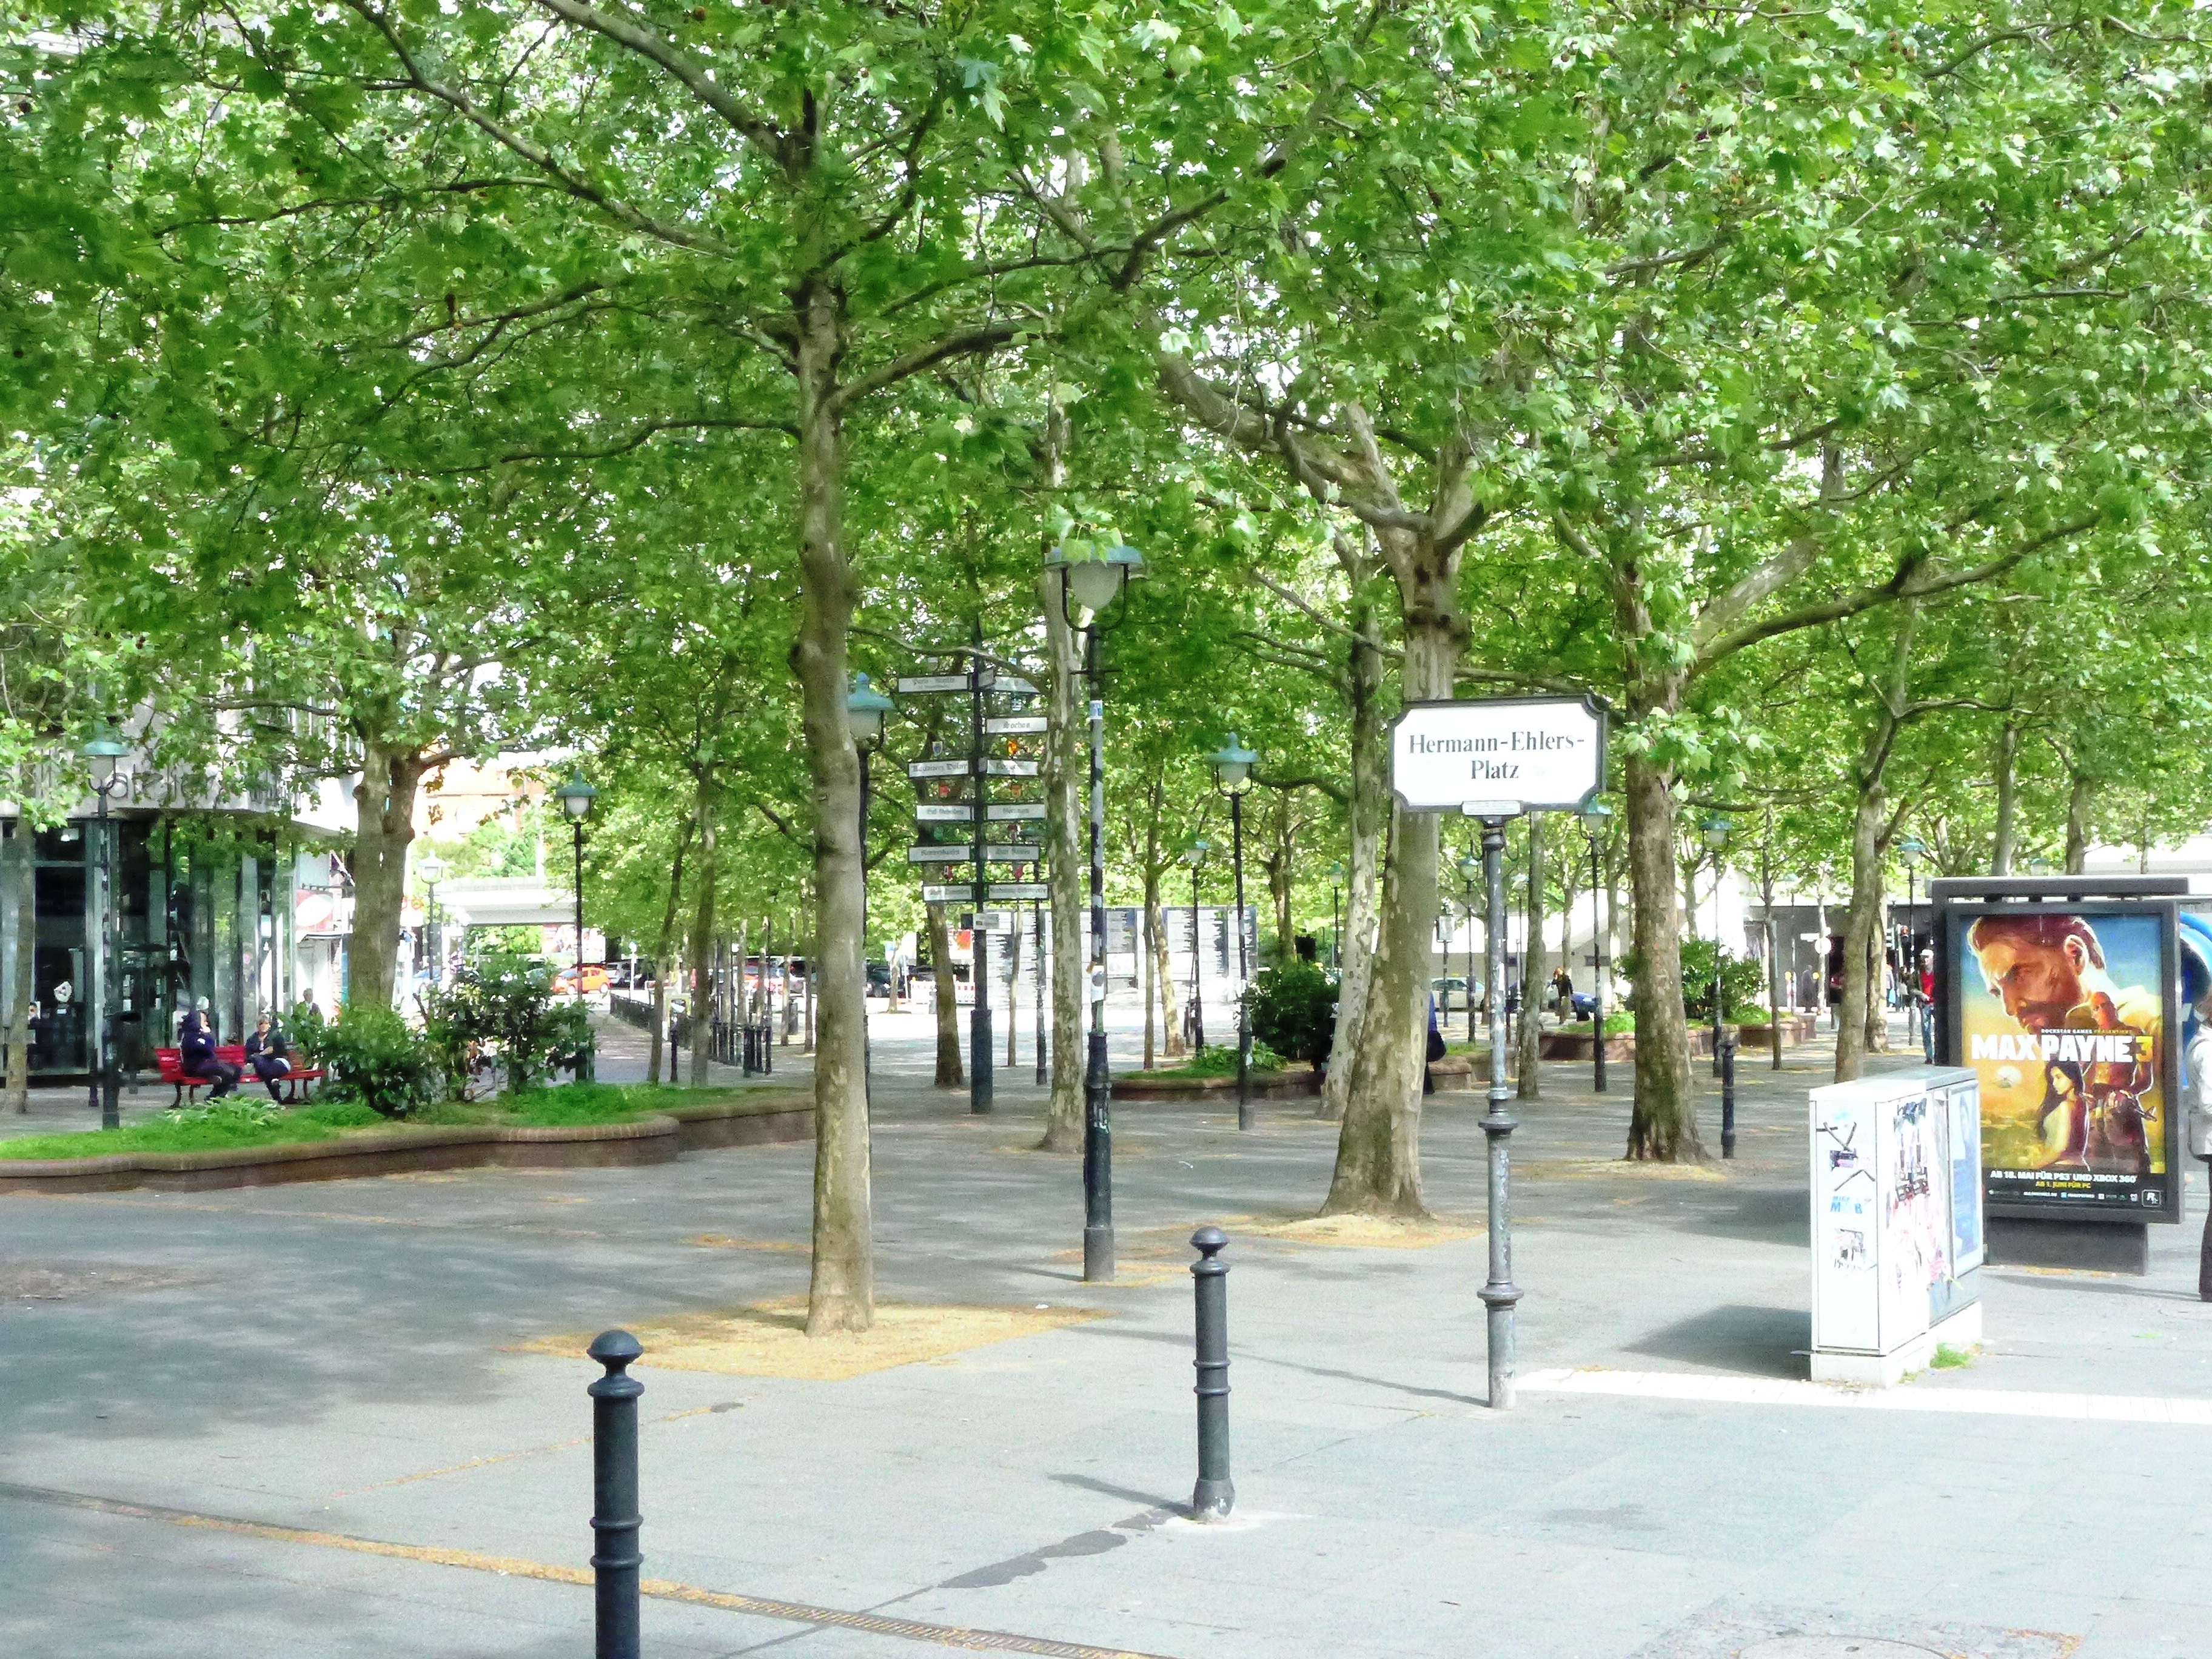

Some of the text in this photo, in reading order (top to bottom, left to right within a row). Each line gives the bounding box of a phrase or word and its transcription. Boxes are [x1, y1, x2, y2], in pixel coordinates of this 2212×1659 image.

[1409, 731, 1584, 754] Hermann-Ehlers-
[1470, 760, 1520, 779] Platz
[1971, 1034, 2153, 1062] MAX PAYNE 3
[1990, 1170, 2003, 1179] AB
[2036, 1170, 2053, 1181] FÜR
[2073, 1173, 2093, 1182] UND
[2093, 1174, 2118, 1182] XBOX
